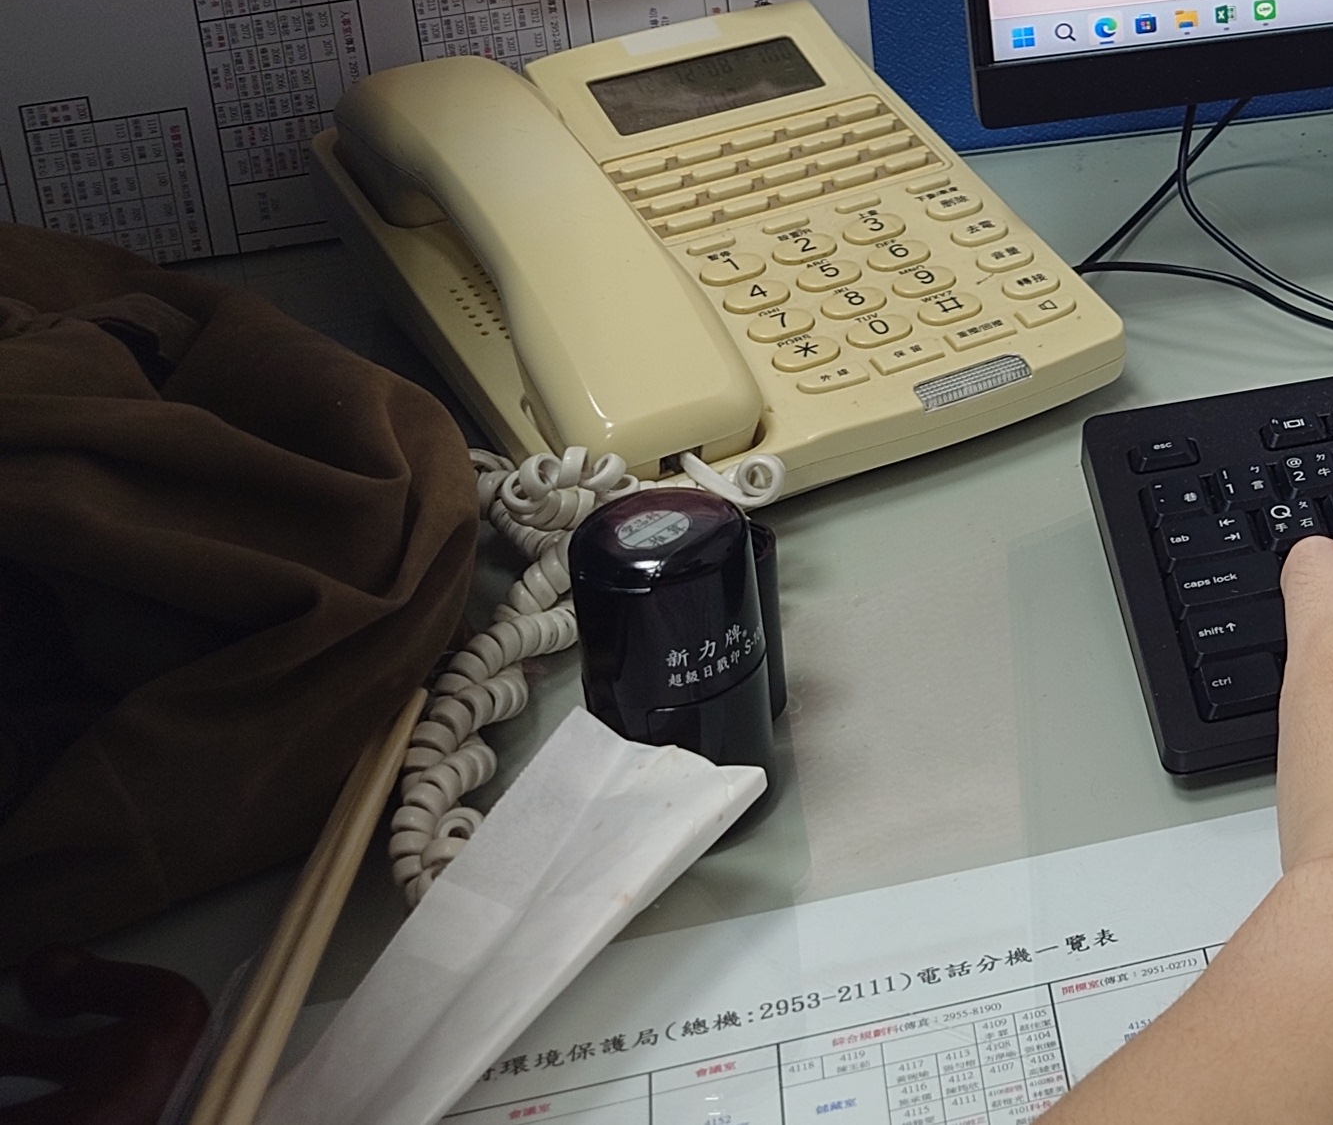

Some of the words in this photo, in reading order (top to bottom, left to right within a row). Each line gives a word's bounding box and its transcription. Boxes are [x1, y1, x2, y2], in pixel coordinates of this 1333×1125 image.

[863, 218, 885, 231] 3
[794, 238, 817, 252] 2
[889, 244, 909, 257] 6
[723, 258, 739, 271] 1
[820, 263, 840, 277] 5
[914, 270, 935, 285] 9
[750, 285, 767, 298] 4
[844, 291, 865, 306] 8
[769, 312, 787, 328] 7
[869, 319, 889, 335] 0
[1153, 441, 1172, 450] esc
[1270, 505, 1292, 519] Q
[1170, 534, 1190, 544] tab
[1184, 579, 1211, 589] caps
[1213, 573, 1238, 584] lock
[1198, 627, 1225, 638] shift
[1212, 677, 1232, 687] ctrl
[1022, 1009, 1047, 1021] 4105
[1030, 1053, 1055, 1065] 4103
[988, 1062, 1015, 1075] 4107
